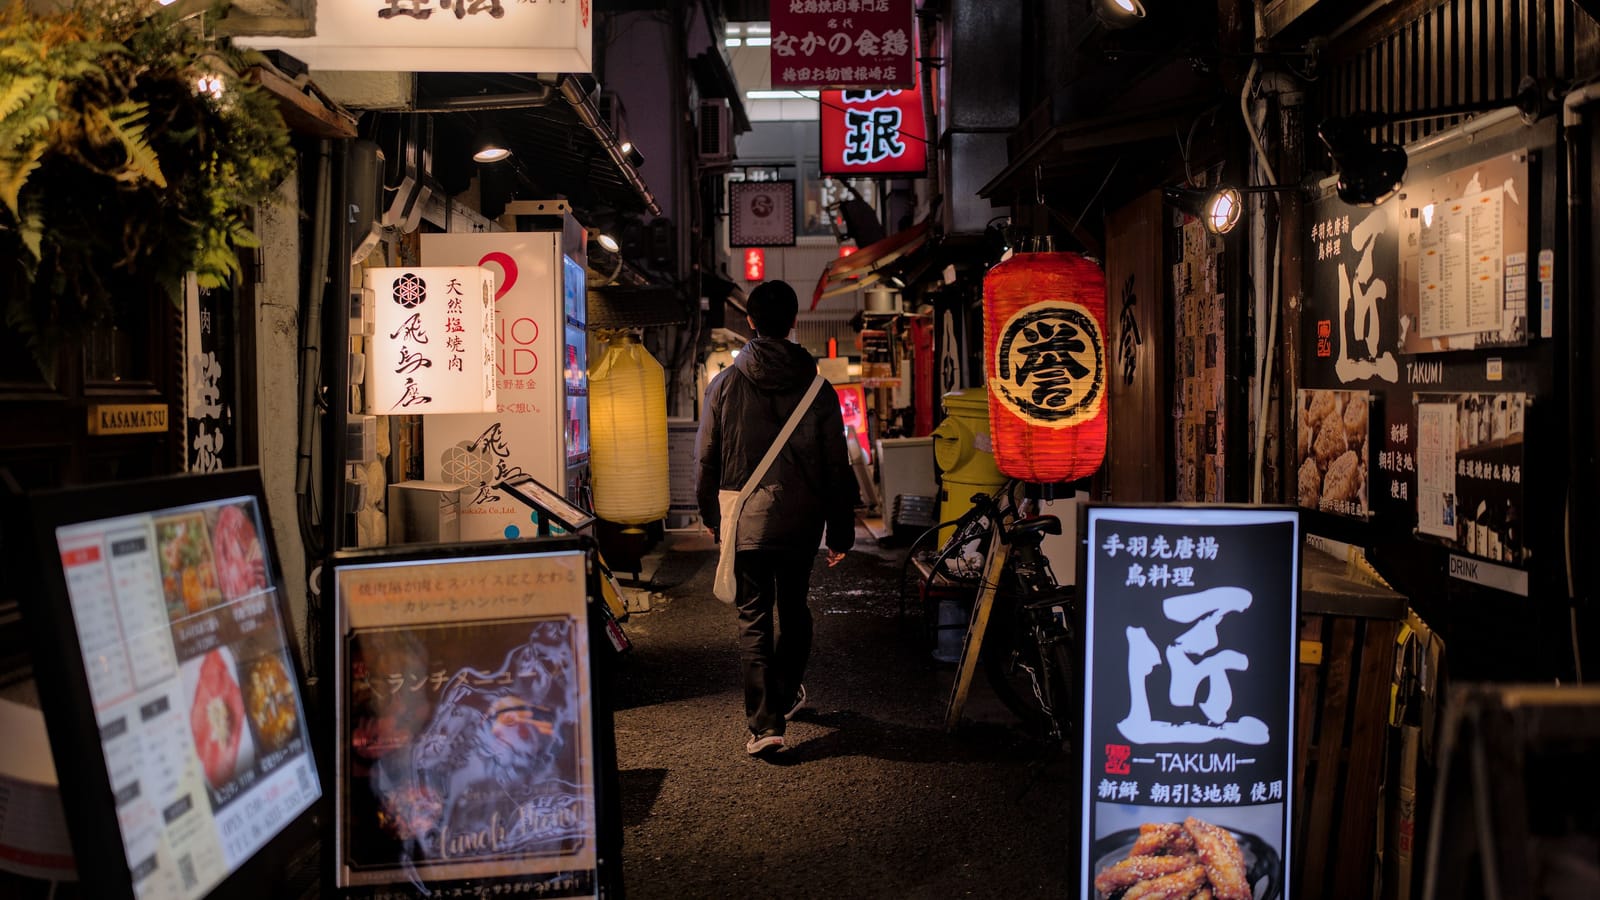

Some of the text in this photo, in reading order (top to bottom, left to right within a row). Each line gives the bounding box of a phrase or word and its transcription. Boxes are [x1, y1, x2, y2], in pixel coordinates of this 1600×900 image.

[1335, 207, 1399, 384] 匠
[444, 278, 466, 373] 天然塩焼肉
[1405, 359, 1444, 384] TAKUMI
[101, 410, 166, 429] KASAMATSU
[1390, 423, 1409, 445] 新鮮
[1378, 449, 1417, 473] 朝引き地
[1390, 479, 1408, 501] 使用
[1101, 532, 1220, 561] 手羽先唐揚
[1124, 562, 1196, 589] 鳥料理
[1449, 557, 1479, 580] DRINK
[1116, 585, 1271, 745] 匠
[1155, 752, 1237, 774] TAKUMI
[1097, 778, 1284, 805] 新鮮 朝引き地鶏 使用
